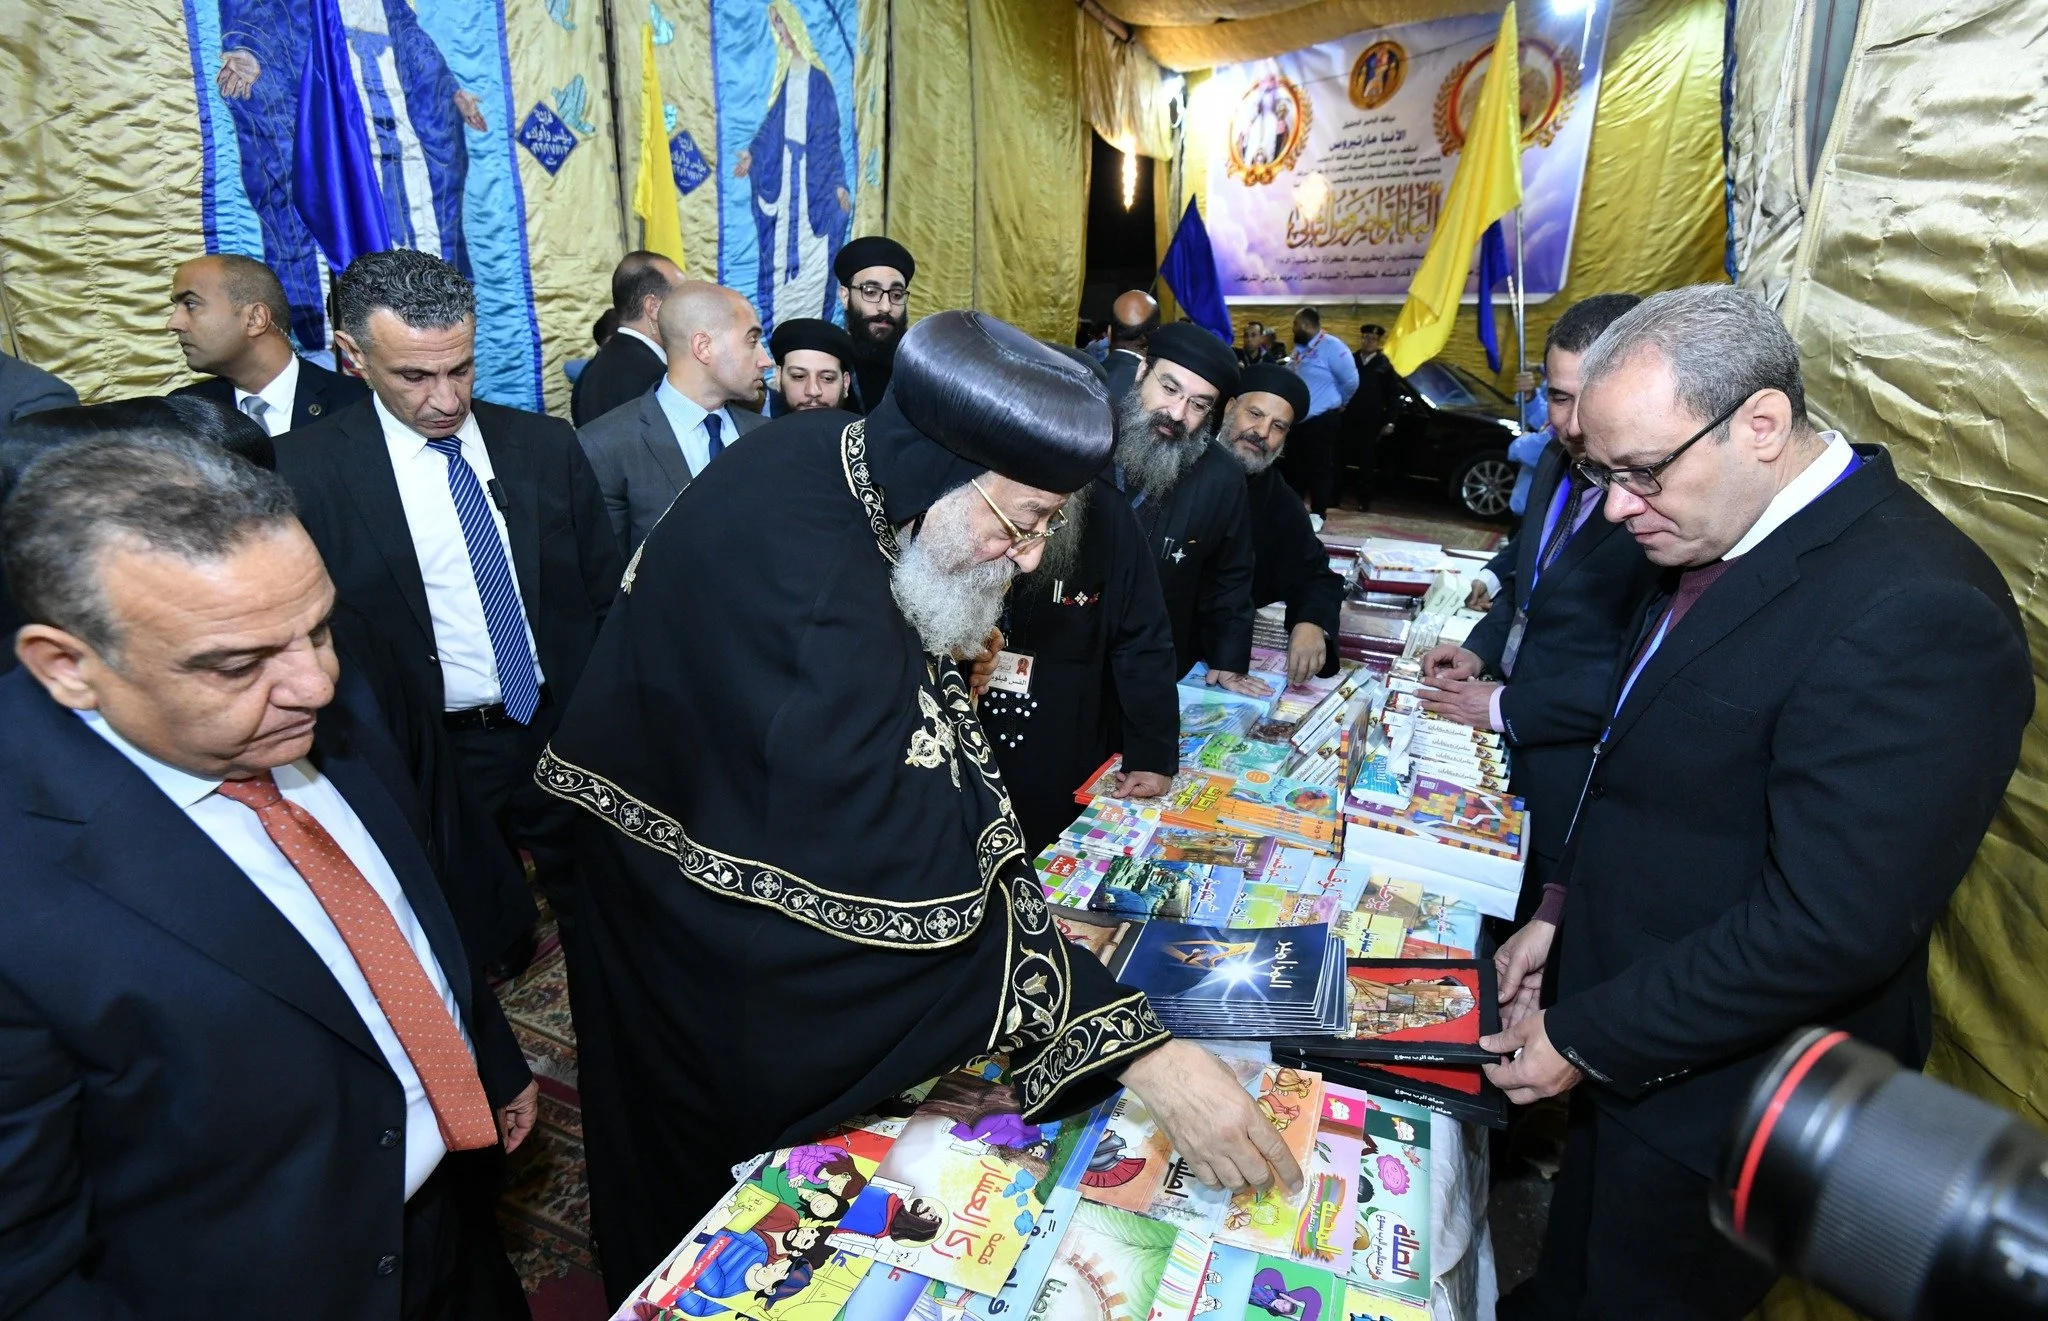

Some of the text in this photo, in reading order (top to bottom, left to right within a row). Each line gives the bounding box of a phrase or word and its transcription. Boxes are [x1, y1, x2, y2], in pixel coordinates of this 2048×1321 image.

[1366, 883, 1404, 911] يوحنا
[1269, 940, 1299, 988] المزامير
[931, 1160, 1012, 1260] زكا العشار
[1315, 1200, 1343, 1256] المحبة
[978, 1233, 1006, 1266] قصة
[1375, 1214, 1388, 1276] من تعاليم الرب يسوع
[1392, 1224, 1420, 1280] الصلاة
